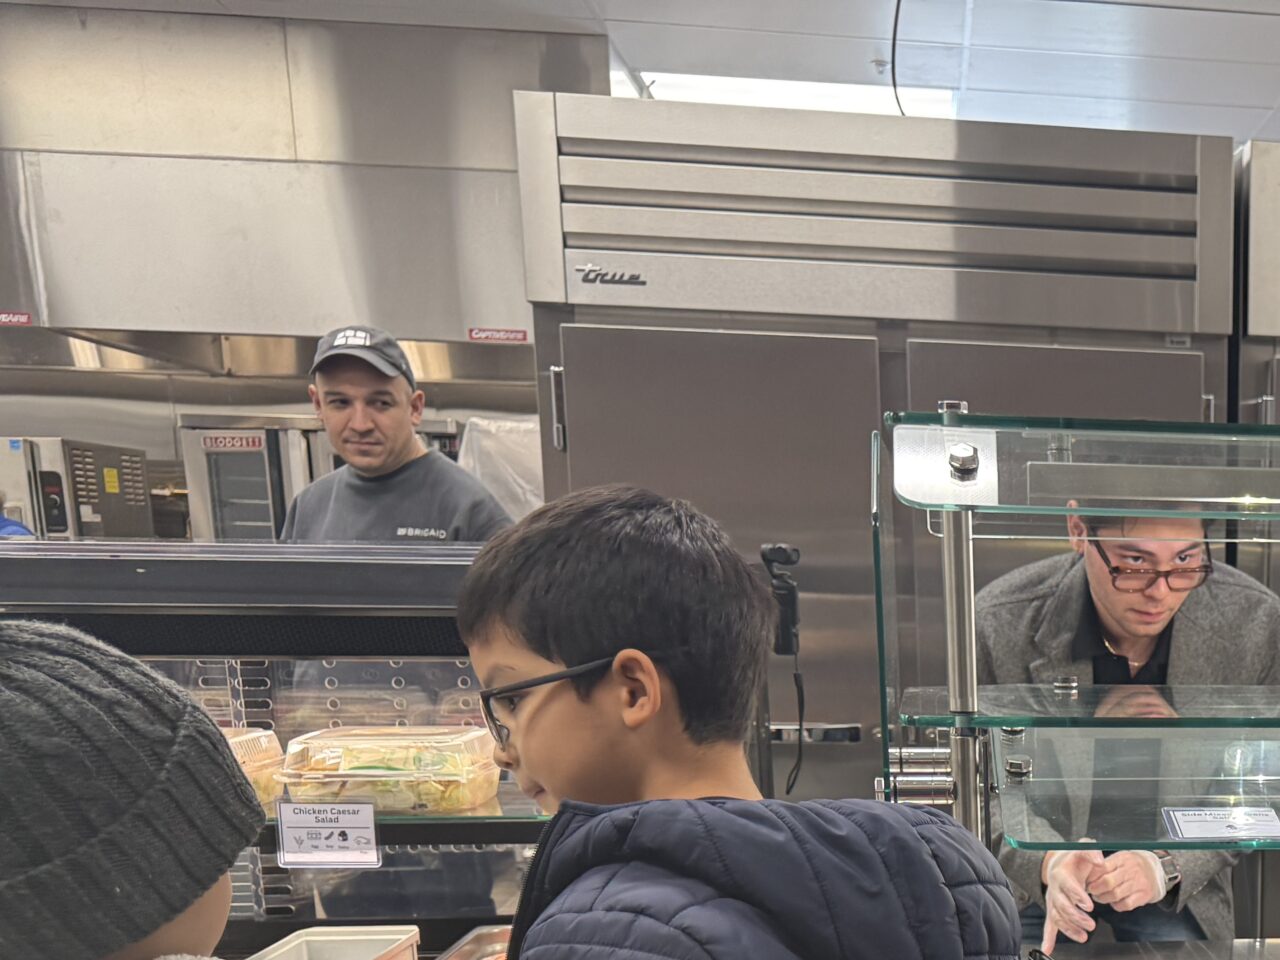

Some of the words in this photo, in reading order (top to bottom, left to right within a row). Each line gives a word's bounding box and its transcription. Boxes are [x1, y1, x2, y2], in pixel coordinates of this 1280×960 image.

[293, 807, 328, 815] Chicken
[330, 807, 361, 816] Caesar
[314, 816, 340, 824] Salad
